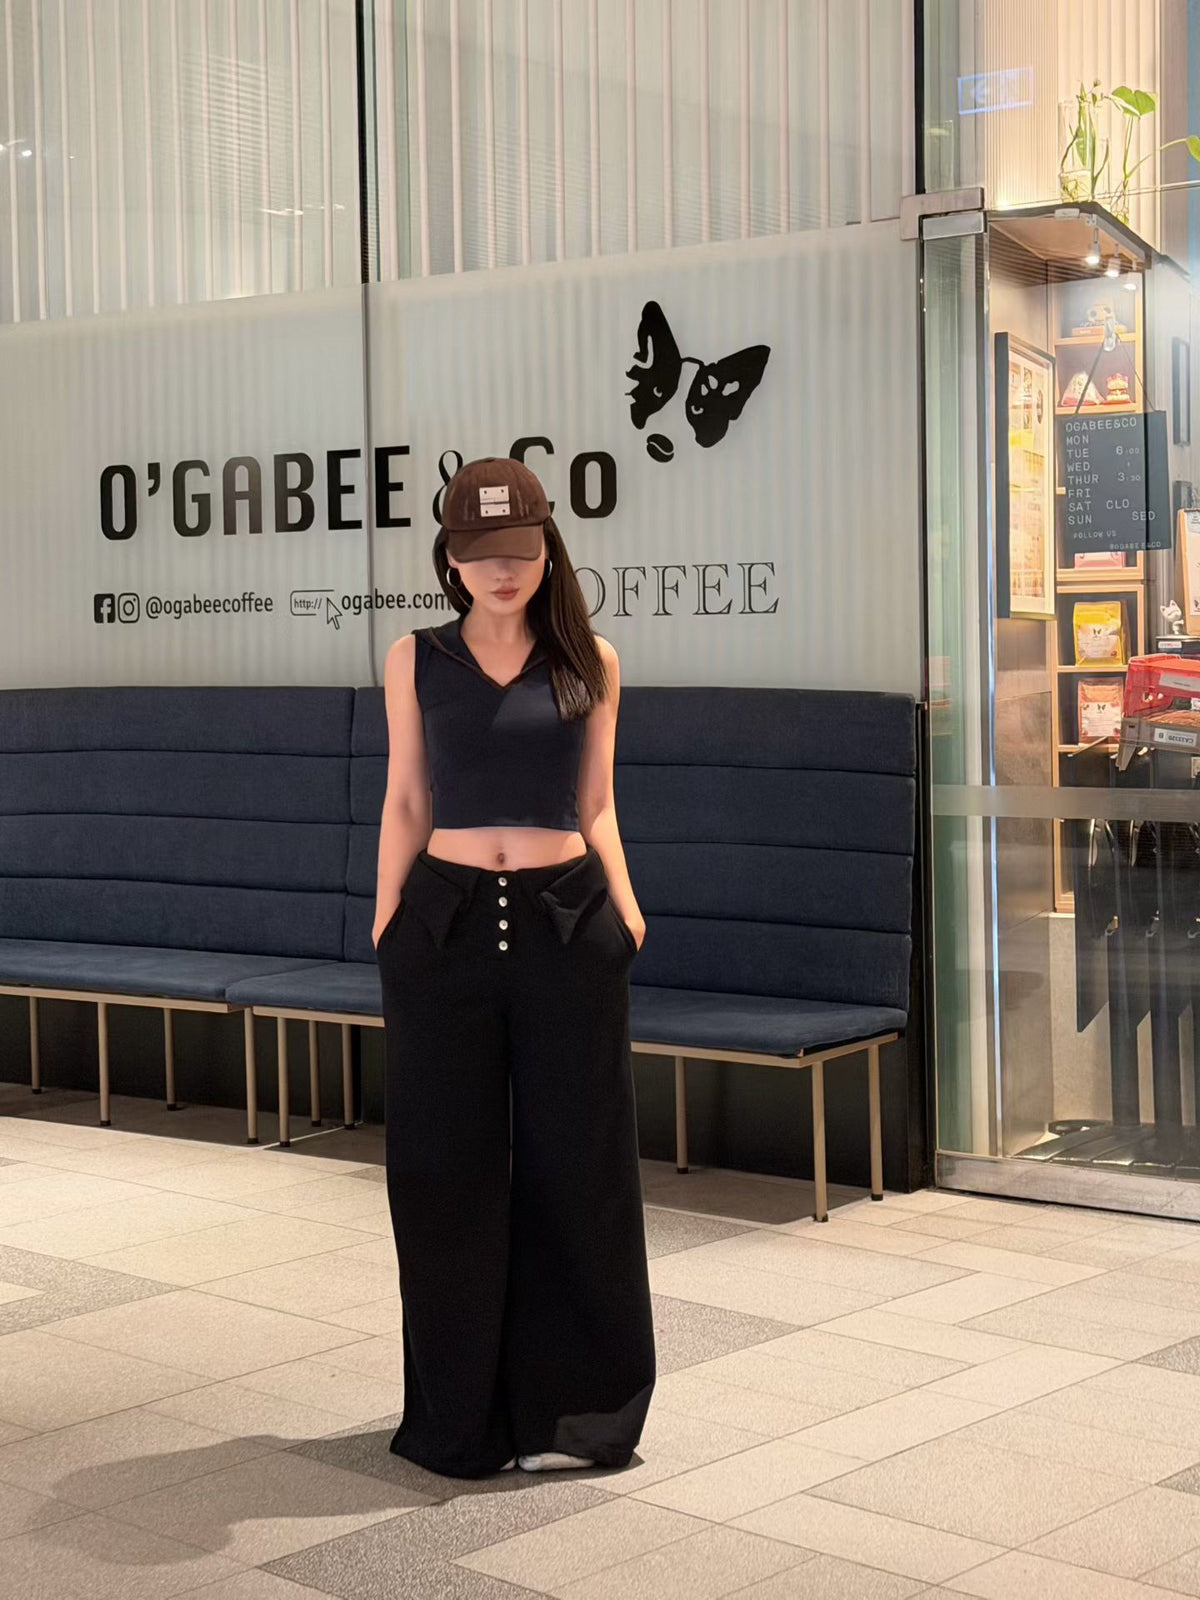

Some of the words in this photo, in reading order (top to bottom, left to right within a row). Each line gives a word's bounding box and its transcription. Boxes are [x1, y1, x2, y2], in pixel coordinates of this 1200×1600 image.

[1065, 417, 1137, 433] OGABEE&CO
[1066, 435, 1089, 445] MON
[1066, 448, 1089, 458] TUE
[1067, 462, 1091, 472] WED
[1067, 474, 1099, 485] THUR
[99, 445, 411, 541] O'GABEE
[1068, 488, 1091, 498] FRI
[1068, 501, 1091, 512] SAT
[1106, 499, 1130, 510] CLO
[1068, 514, 1092, 525] SUN
[1131, 511, 1156, 521] SED
[1073, 531, 1103, 539] FOLLOW
[573, 562, 780, 618] OFFEE
[145, 592, 273, 620] @ogabeecoffee
[294, 598, 322, 610] http://
[341, 588, 452, 616] ogabee.com
